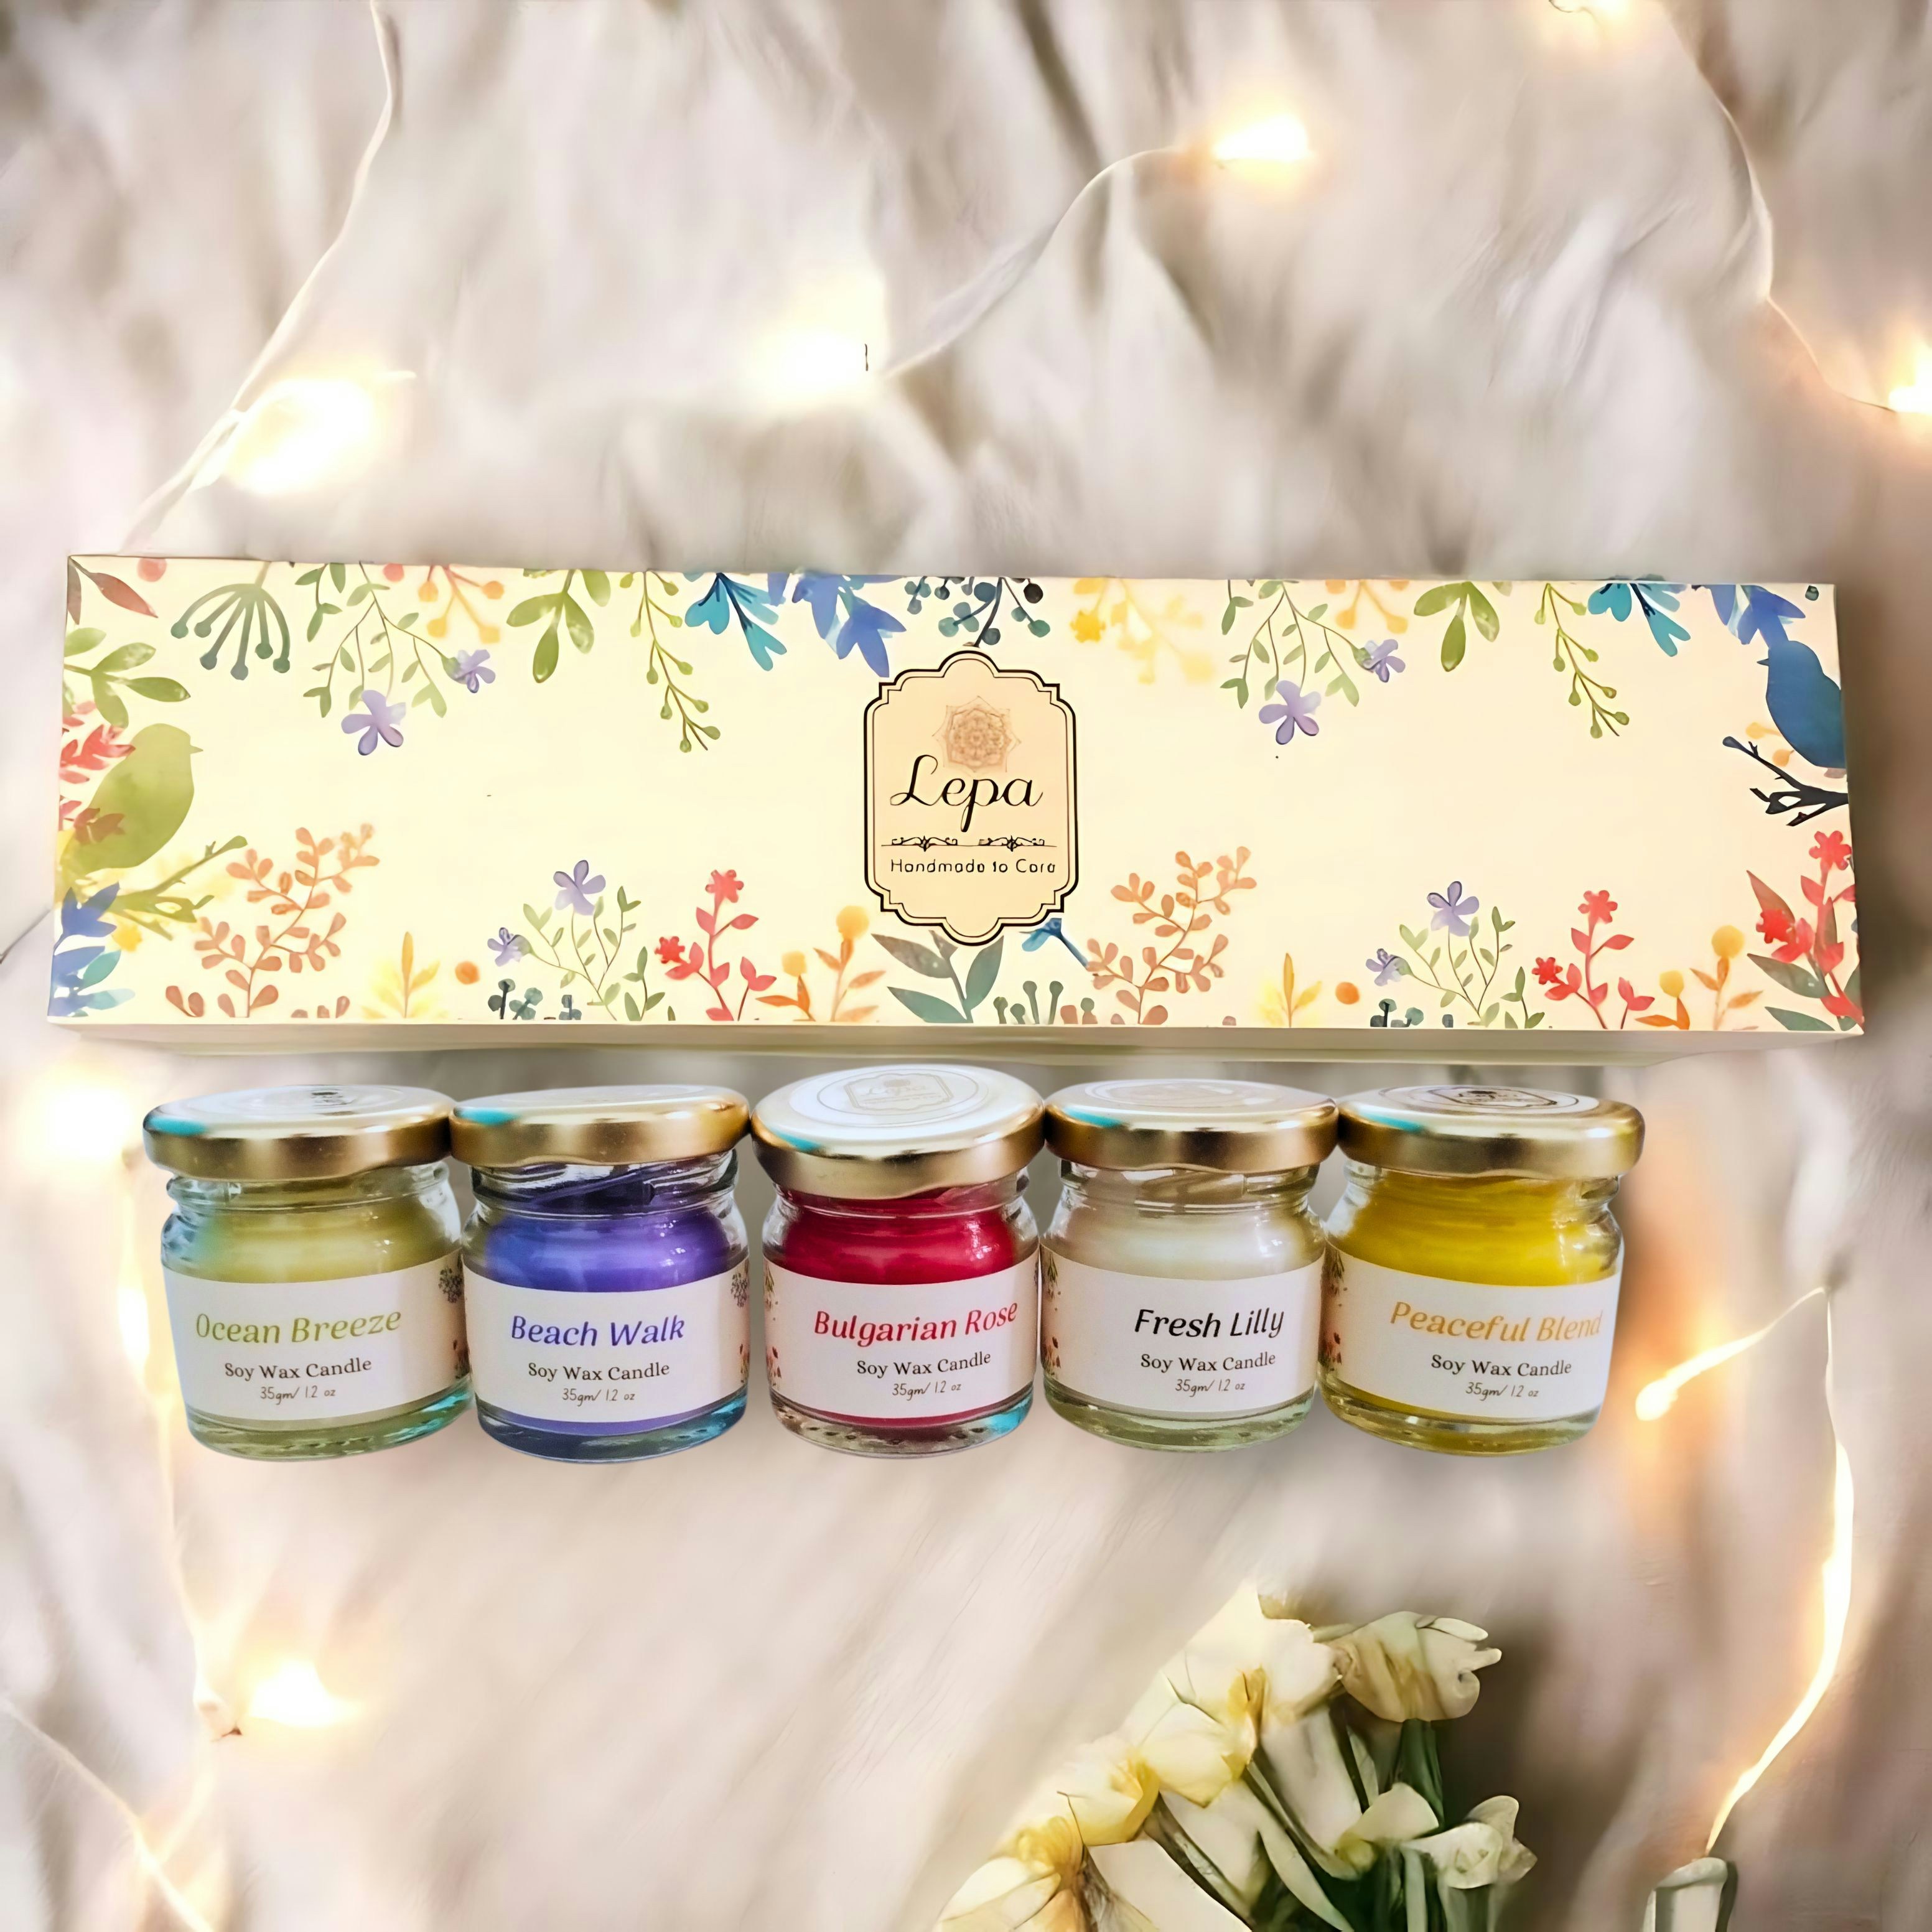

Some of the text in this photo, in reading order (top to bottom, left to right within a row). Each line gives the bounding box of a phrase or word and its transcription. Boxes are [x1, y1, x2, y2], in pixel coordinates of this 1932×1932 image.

[890, 754, 1043, 833] Lepa
[196, 1312, 401, 1344] Ocean Breeze
[511, 1315, 684, 1346] Beach Walk
[814, 1302, 1018, 1348] Bulgarian Rose
[1134, 1307, 1284, 1338] Fresh Lilly
[1390, 1301, 1603, 1342] Peaceful Blend
[225, 1357, 371, 1382] Soy Wax Candle
[528, 1361, 670, 1383] Soy Wax Candle
[857, 1351, 991, 1379] Soy Wax Candle
[1141, 1351, 1276, 1373] Soy Wax Candle
[1431, 1354, 1572, 1377] Soy Wax Candle
[324, 1389, 336, 1397] oz
[951, 1383, 962, 1391] oz
[1234, 1383, 1246, 1391] oz
